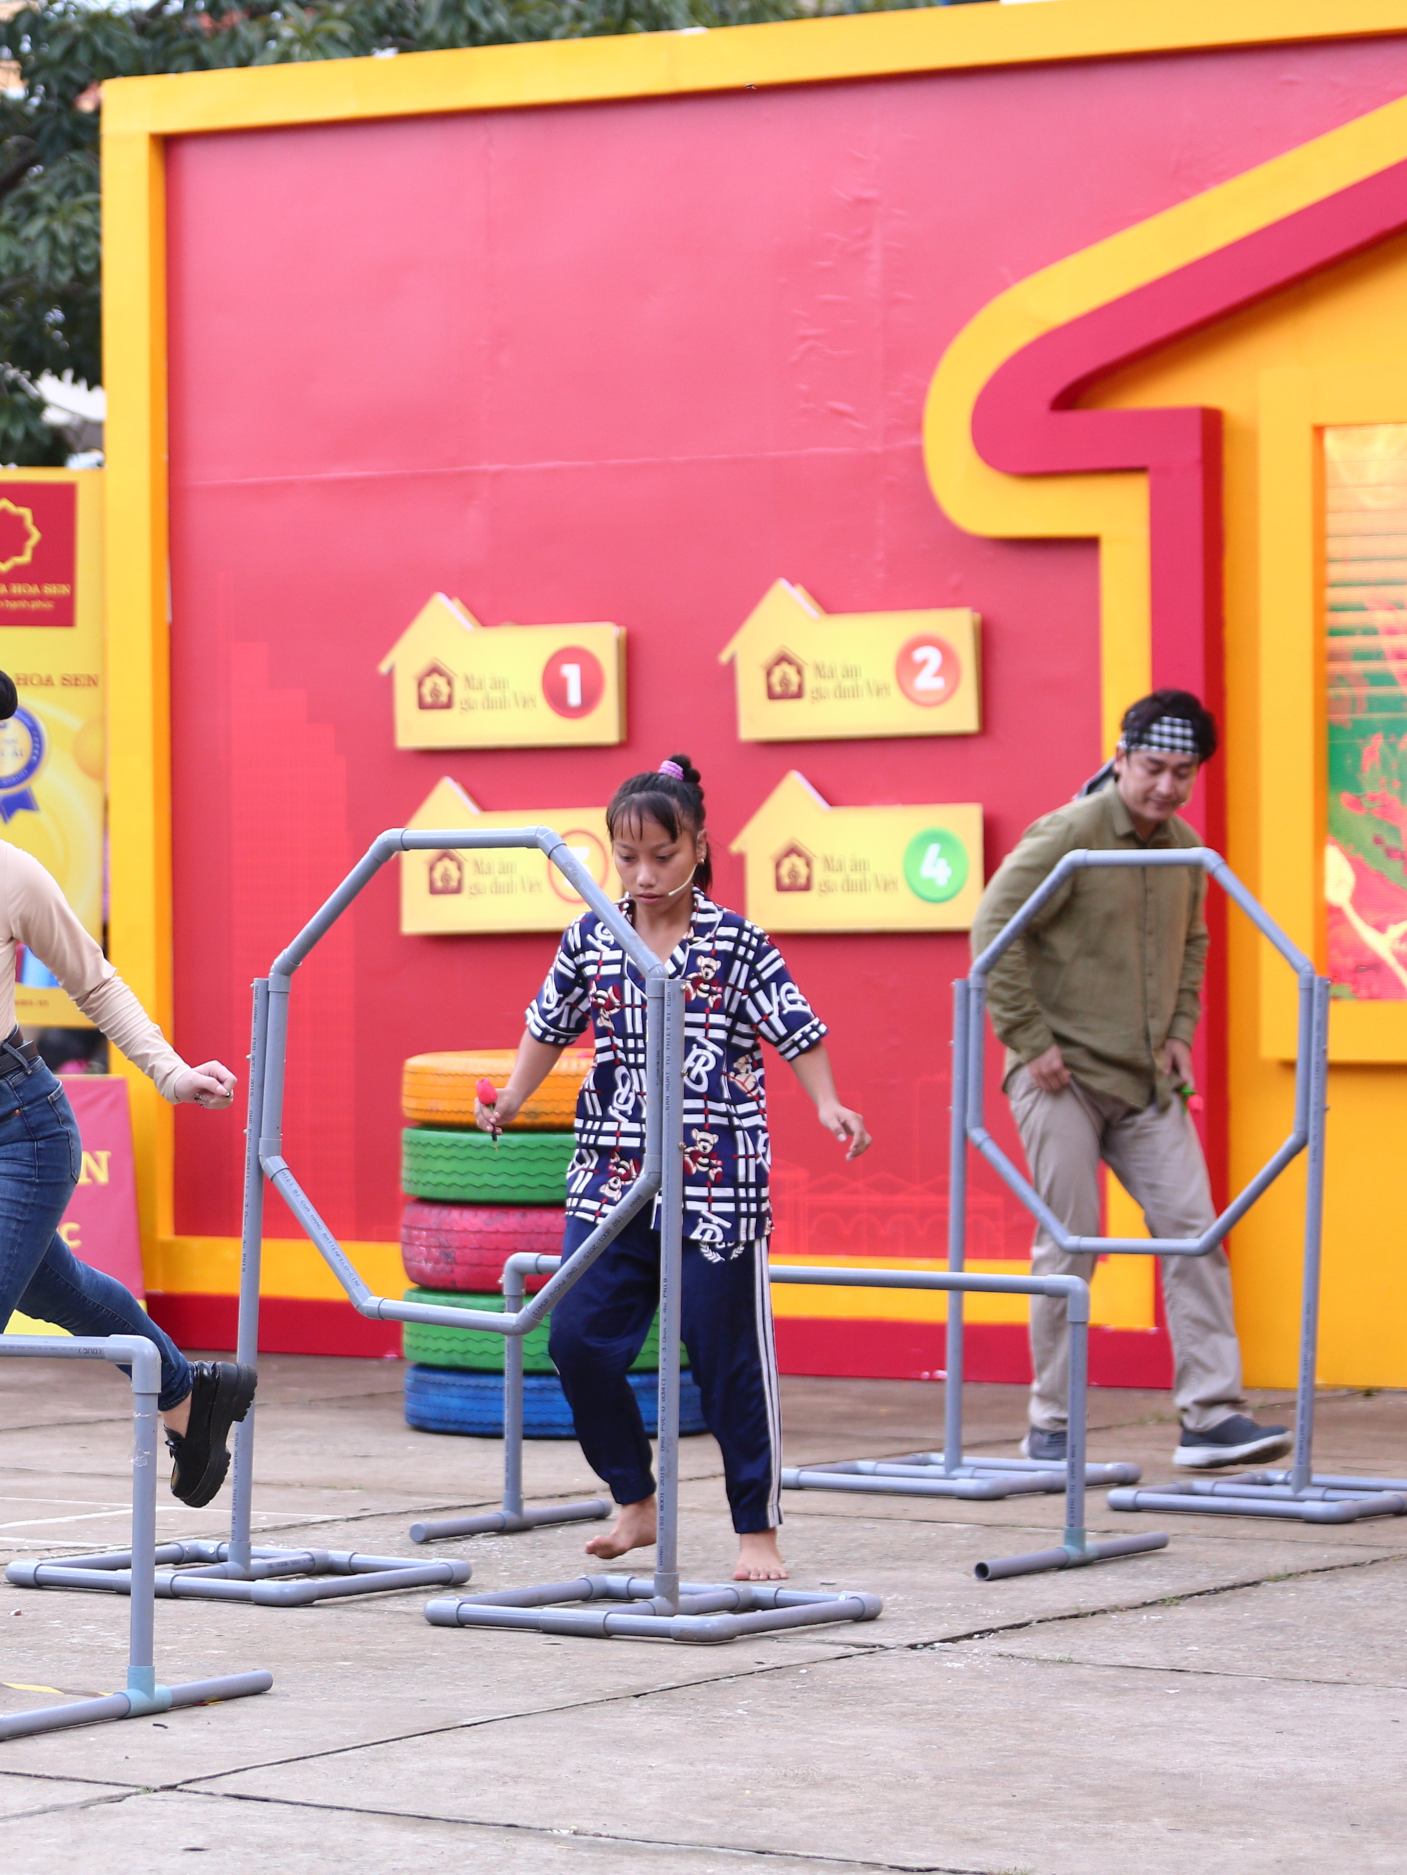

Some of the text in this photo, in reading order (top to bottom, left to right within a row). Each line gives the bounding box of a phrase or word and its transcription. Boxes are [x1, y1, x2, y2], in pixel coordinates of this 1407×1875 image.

[10, 582, 40, 594] HOA
[43, 583, 71, 595] SEN
[14, 672, 100, 687] HOA SEN
[911, 645, 946, 690] 2
[560, 663, 582, 707] 1
[920, 843, 952, 886] 4
[280, 1170, 294, 1187] HIET
